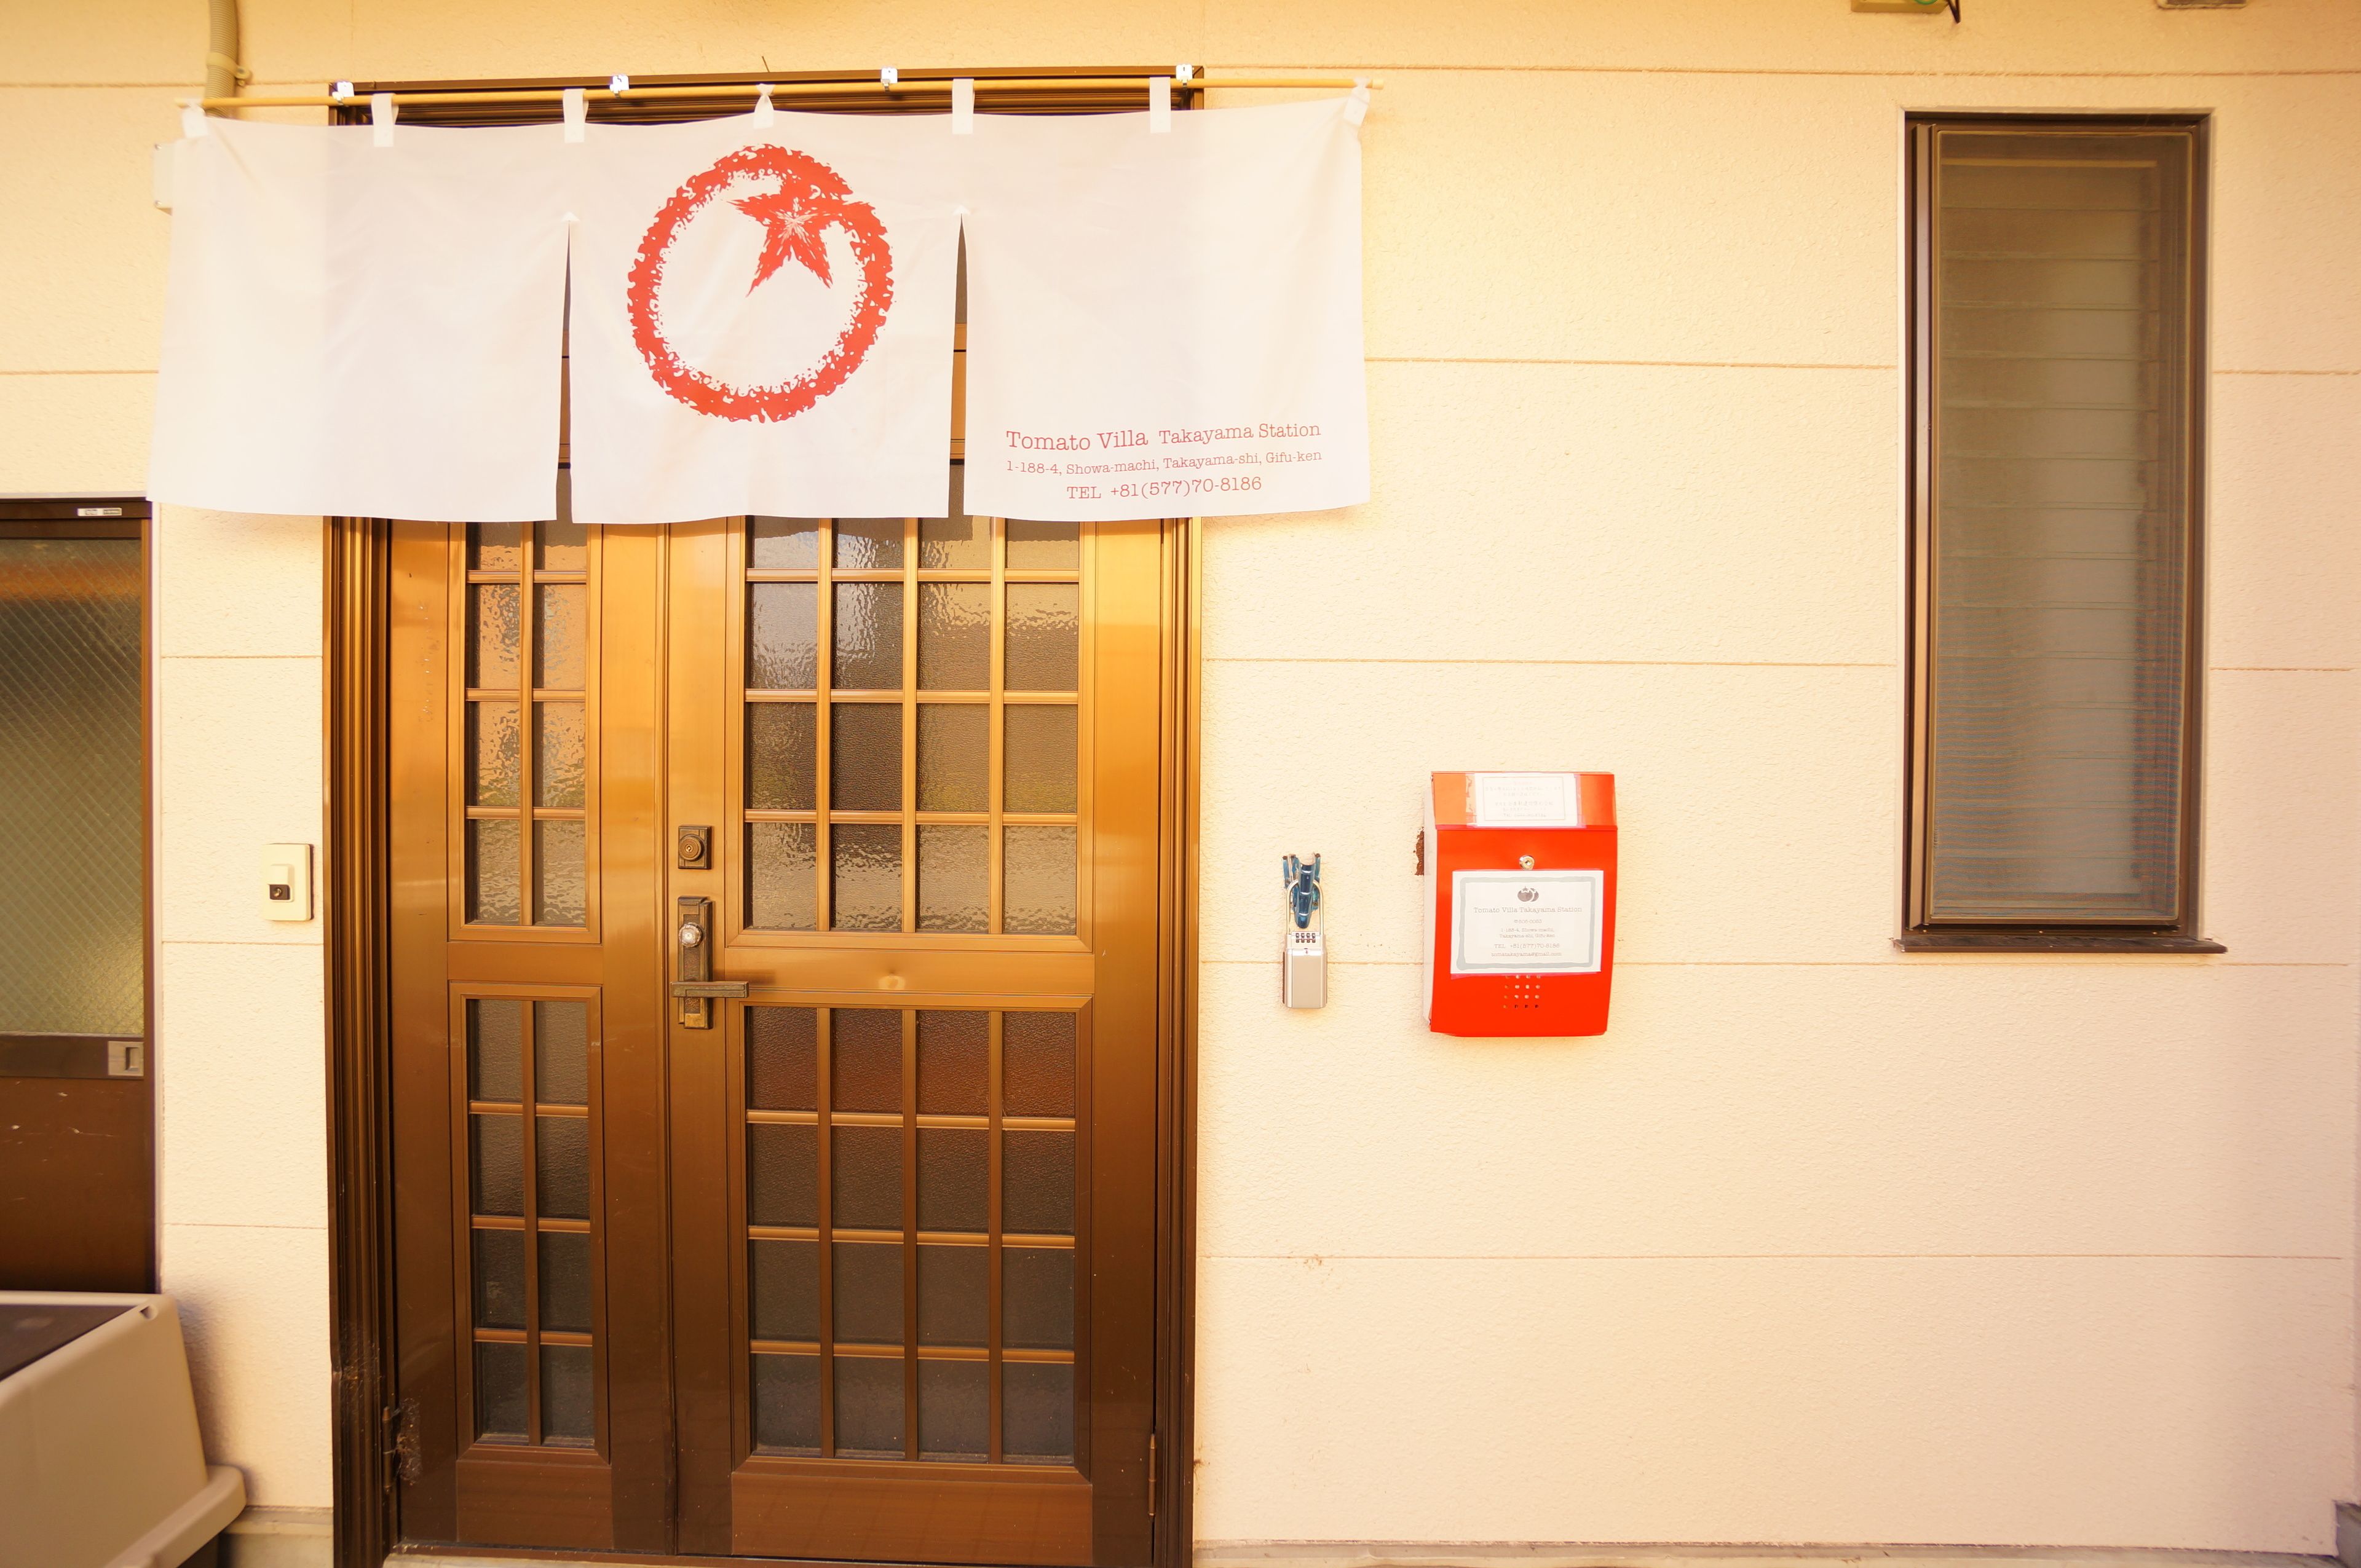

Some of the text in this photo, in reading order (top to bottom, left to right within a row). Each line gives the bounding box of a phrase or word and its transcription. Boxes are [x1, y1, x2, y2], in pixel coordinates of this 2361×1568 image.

[1006, 423, 1322, 451] Tomato Villa Takayama Station
[1006, 451, 1323, 476] 1-188-4, Showa-machi, Takayama-shi, Gifu-ken
[1066, 476, 1262, 499] TEL +81(577)70-8186
